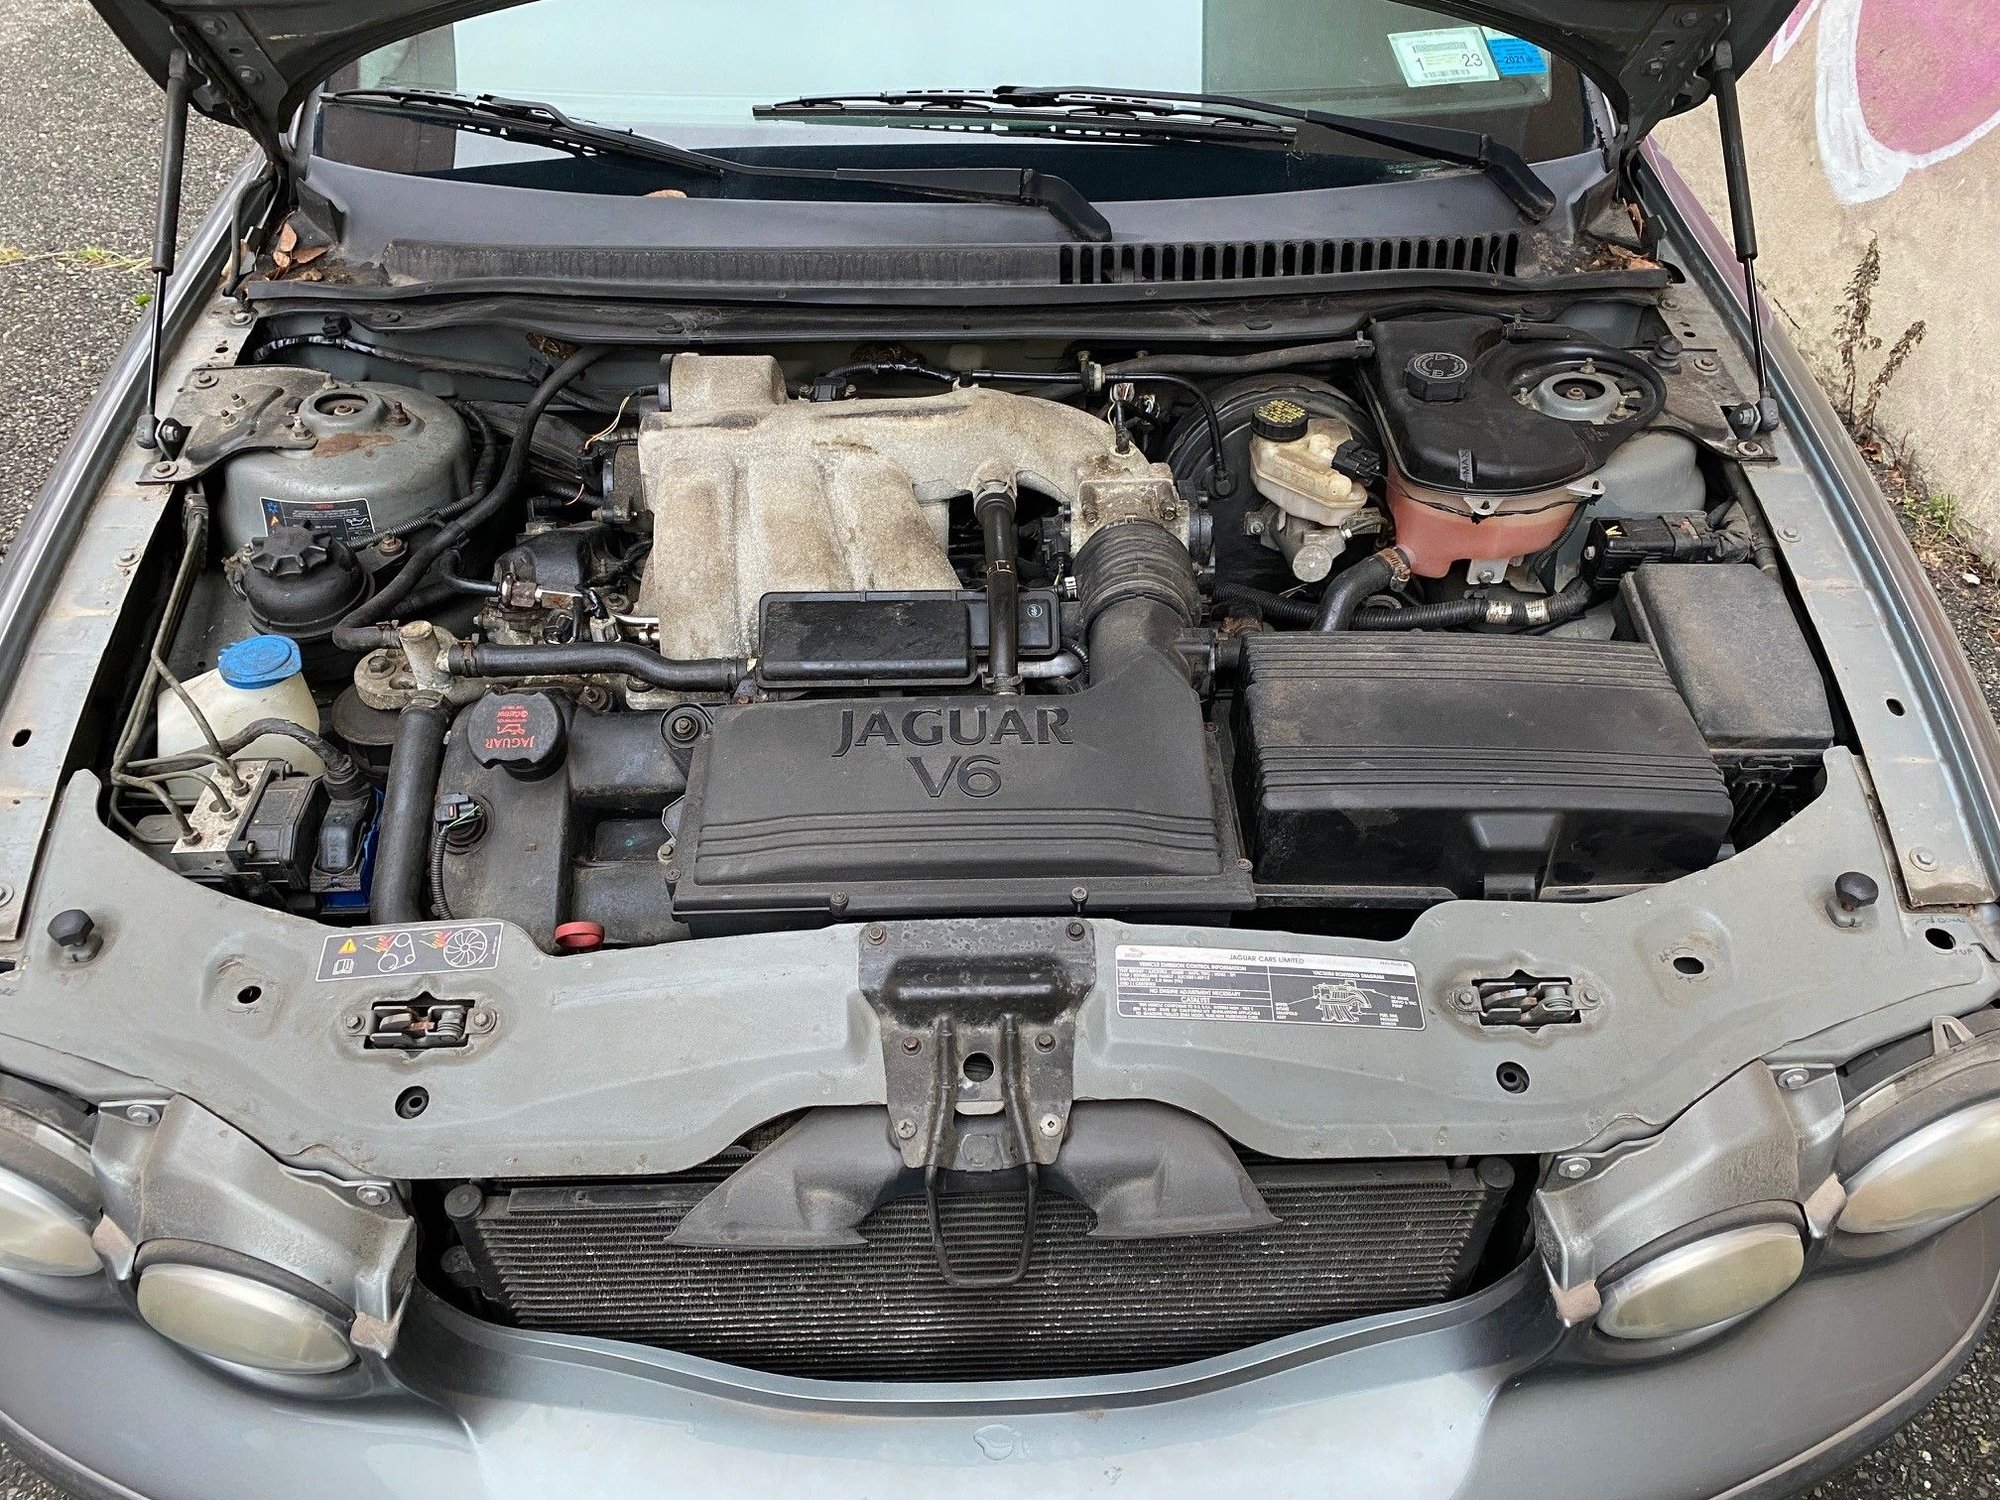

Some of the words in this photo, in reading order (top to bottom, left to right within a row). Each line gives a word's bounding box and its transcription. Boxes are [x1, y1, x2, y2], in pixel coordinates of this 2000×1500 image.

[1416, 57, 1425, 71] 1
[1461, 53, 1483, 67] 23
[1504, 55, 1525, 64] 2021
[1461, 451, 1470, 475] MAX
[831, 706, 1074, 757] JAGUAR
[485, 735, 535, 749] JAGUAR
[907, 754, 1002, 798] V6
[1230, 954, 1256, 962] JAGUAR
[1279, 957, 1305, 965] LIMITED
